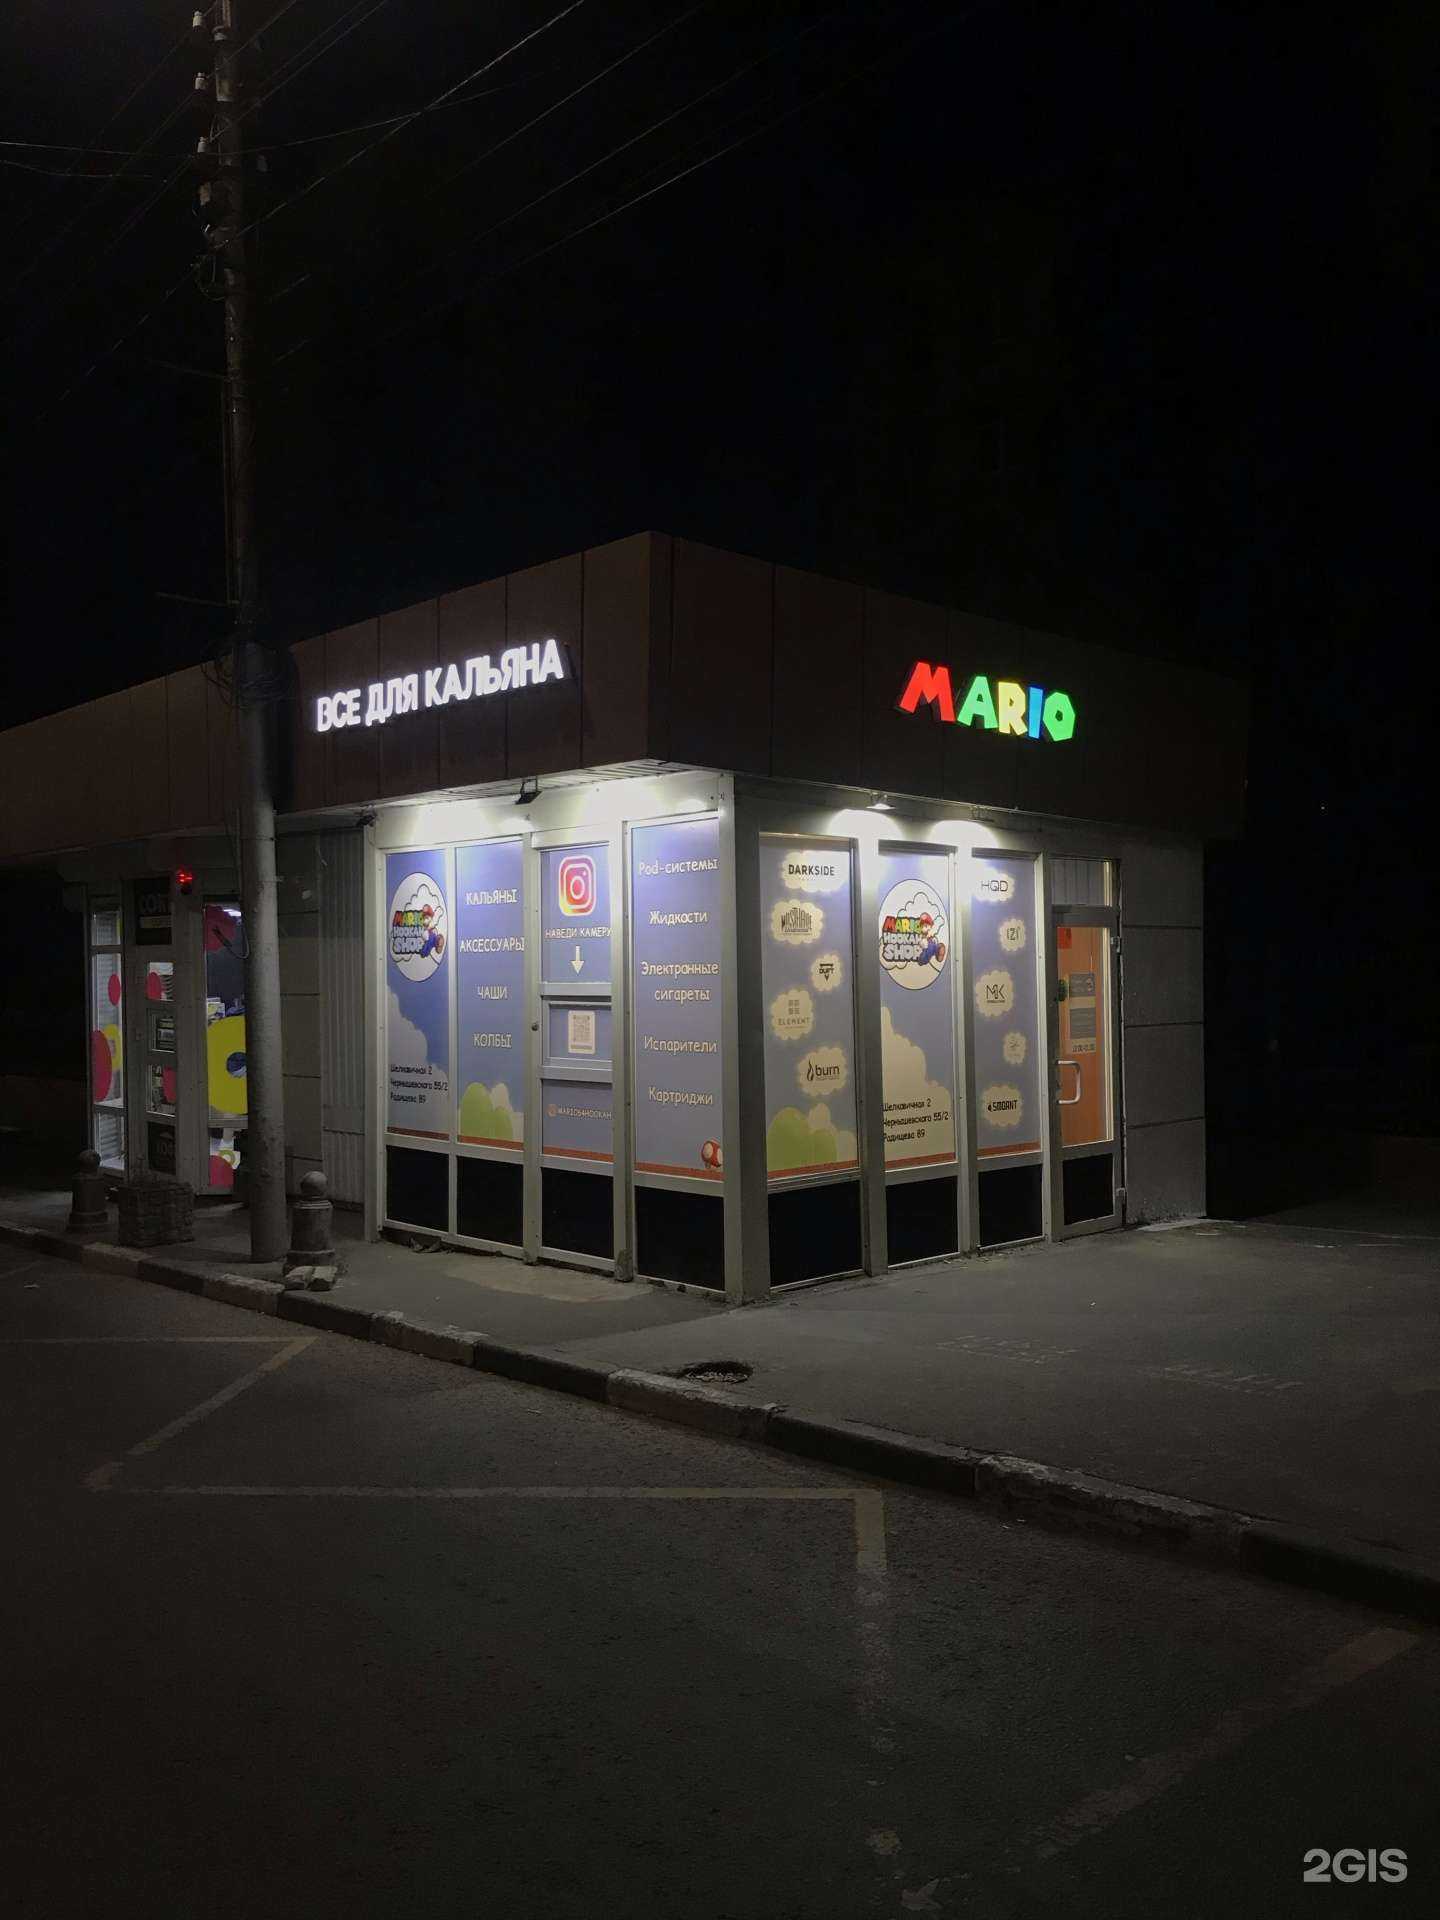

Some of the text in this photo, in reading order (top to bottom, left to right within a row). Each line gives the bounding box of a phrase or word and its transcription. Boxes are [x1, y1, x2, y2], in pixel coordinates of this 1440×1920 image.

[315, 639, 564, 733] ВСЕ ДЛЯ КАЛЬЯНА
[899, 661, 1076, 742] MARIO
[639, 857, 719, 876] Pod-системы
[788, 864, 835, 876] DARKSIDE
[981, 880, 1008, 892] HQD
[466, 889, 518, 905] КАЛЬЯНЫ
[649, 910, 708, 926] Жидкости
[882, 915, 921, 934] MARIO
[545, 927, 613, 939] НАВЕДИ КАМЕРУ
[393, 938, 424, 953] SHOP
[460, 937, 525, 953] АКСЕССУАРЫ
[883, 944, 922, 961] SHOP
[641, 961, 719, 980] Электронные
[477, 986, 508, 999] ЧАШИ
[654, 988, 711, 1003] сигареты
[474, 1034, 512, 1048] КОЛБЫ
[644, 1036, 718, 1055] Испарители
[815, 1065, 840, 1077] burn
[649, 1087, 713, 1105] Картриджи
[926, 1098, 932, 1107] 2
[933, 1111, 949, 1121] 55/2
